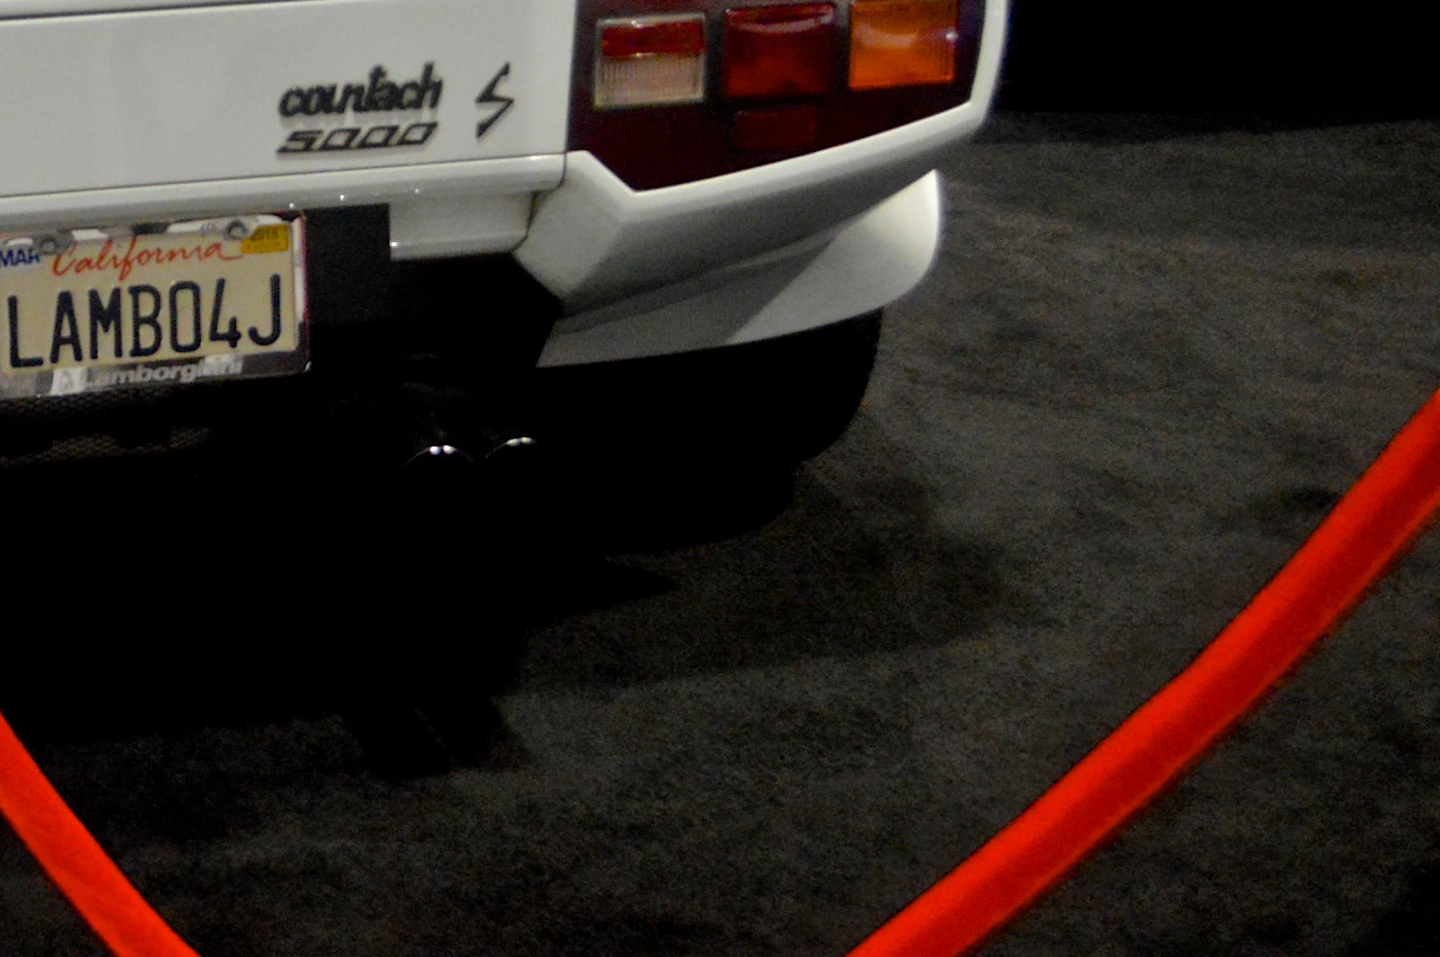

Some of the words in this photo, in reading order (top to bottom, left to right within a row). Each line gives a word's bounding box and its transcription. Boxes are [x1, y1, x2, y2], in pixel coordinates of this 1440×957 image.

[278, 61, 443, 118] countach
[276, 122, 439, 154] 5000
[52, 238, 243, 281] California
